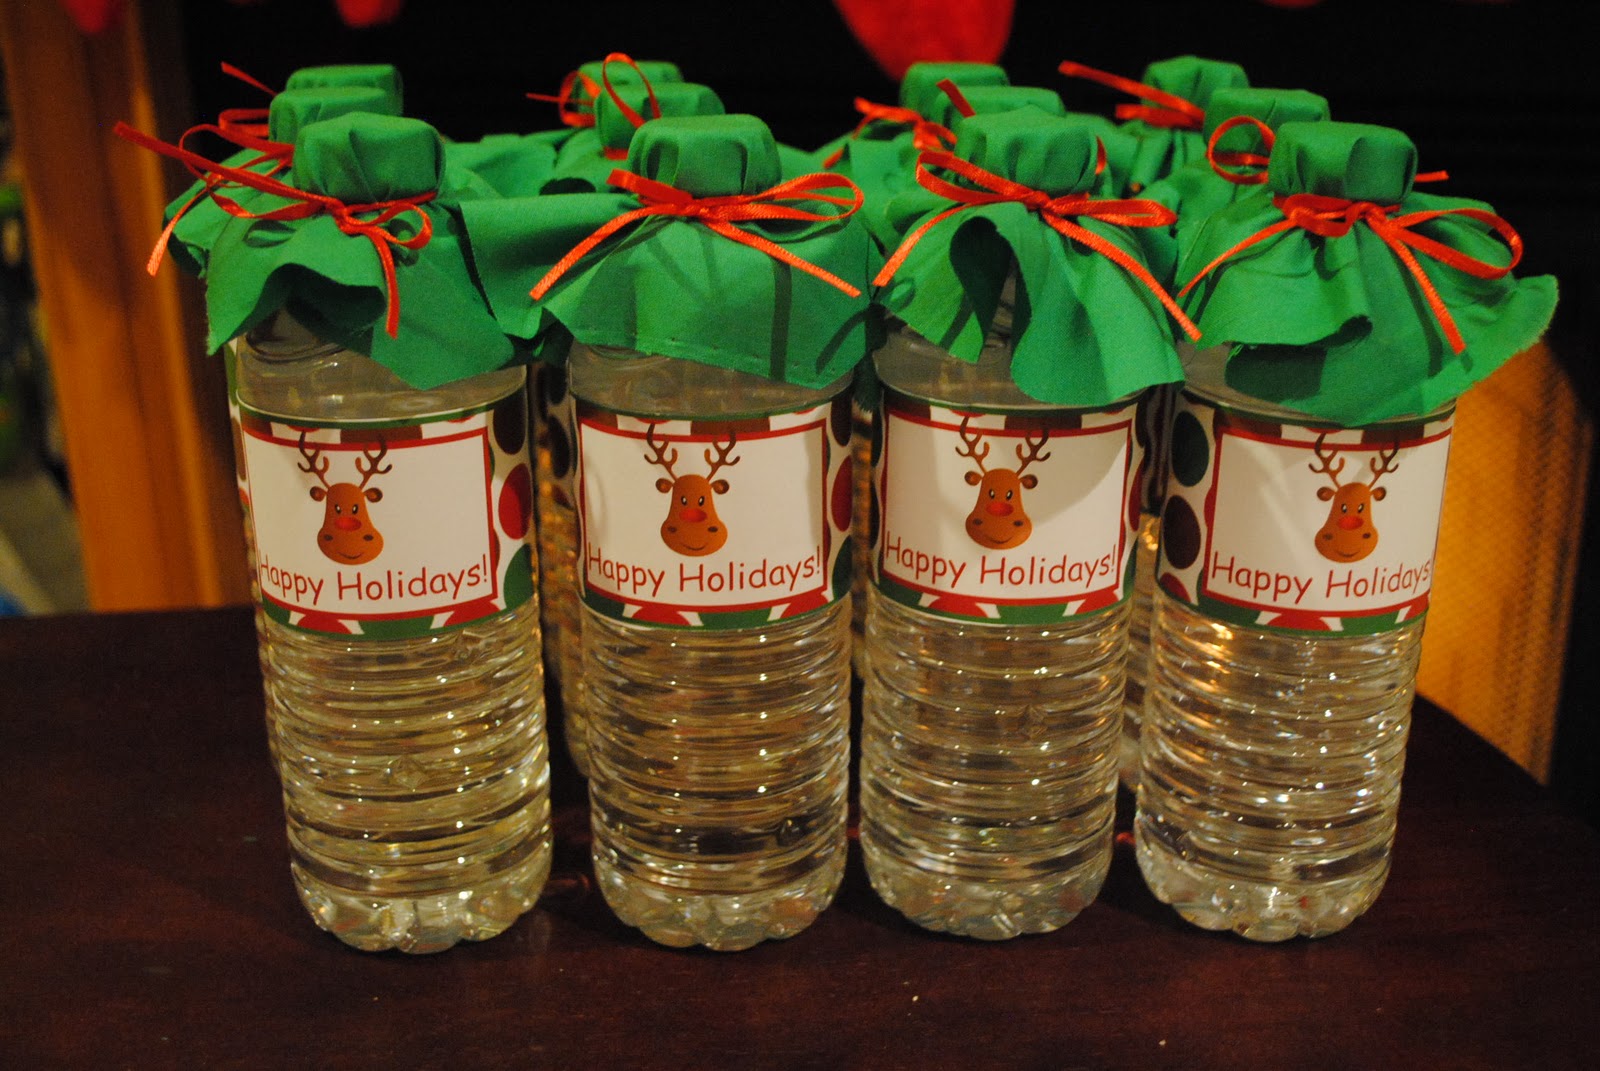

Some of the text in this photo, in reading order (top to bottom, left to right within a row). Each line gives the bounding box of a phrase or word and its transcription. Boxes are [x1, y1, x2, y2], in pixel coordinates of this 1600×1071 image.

[337, 553, 488, 600] Holidays!
[588, 542, 820, 597] Happy Holidays!
[885, 531, 1116, 588] Happy Holidays!
[1211, 551, 1432, 605] Happy Holidays
